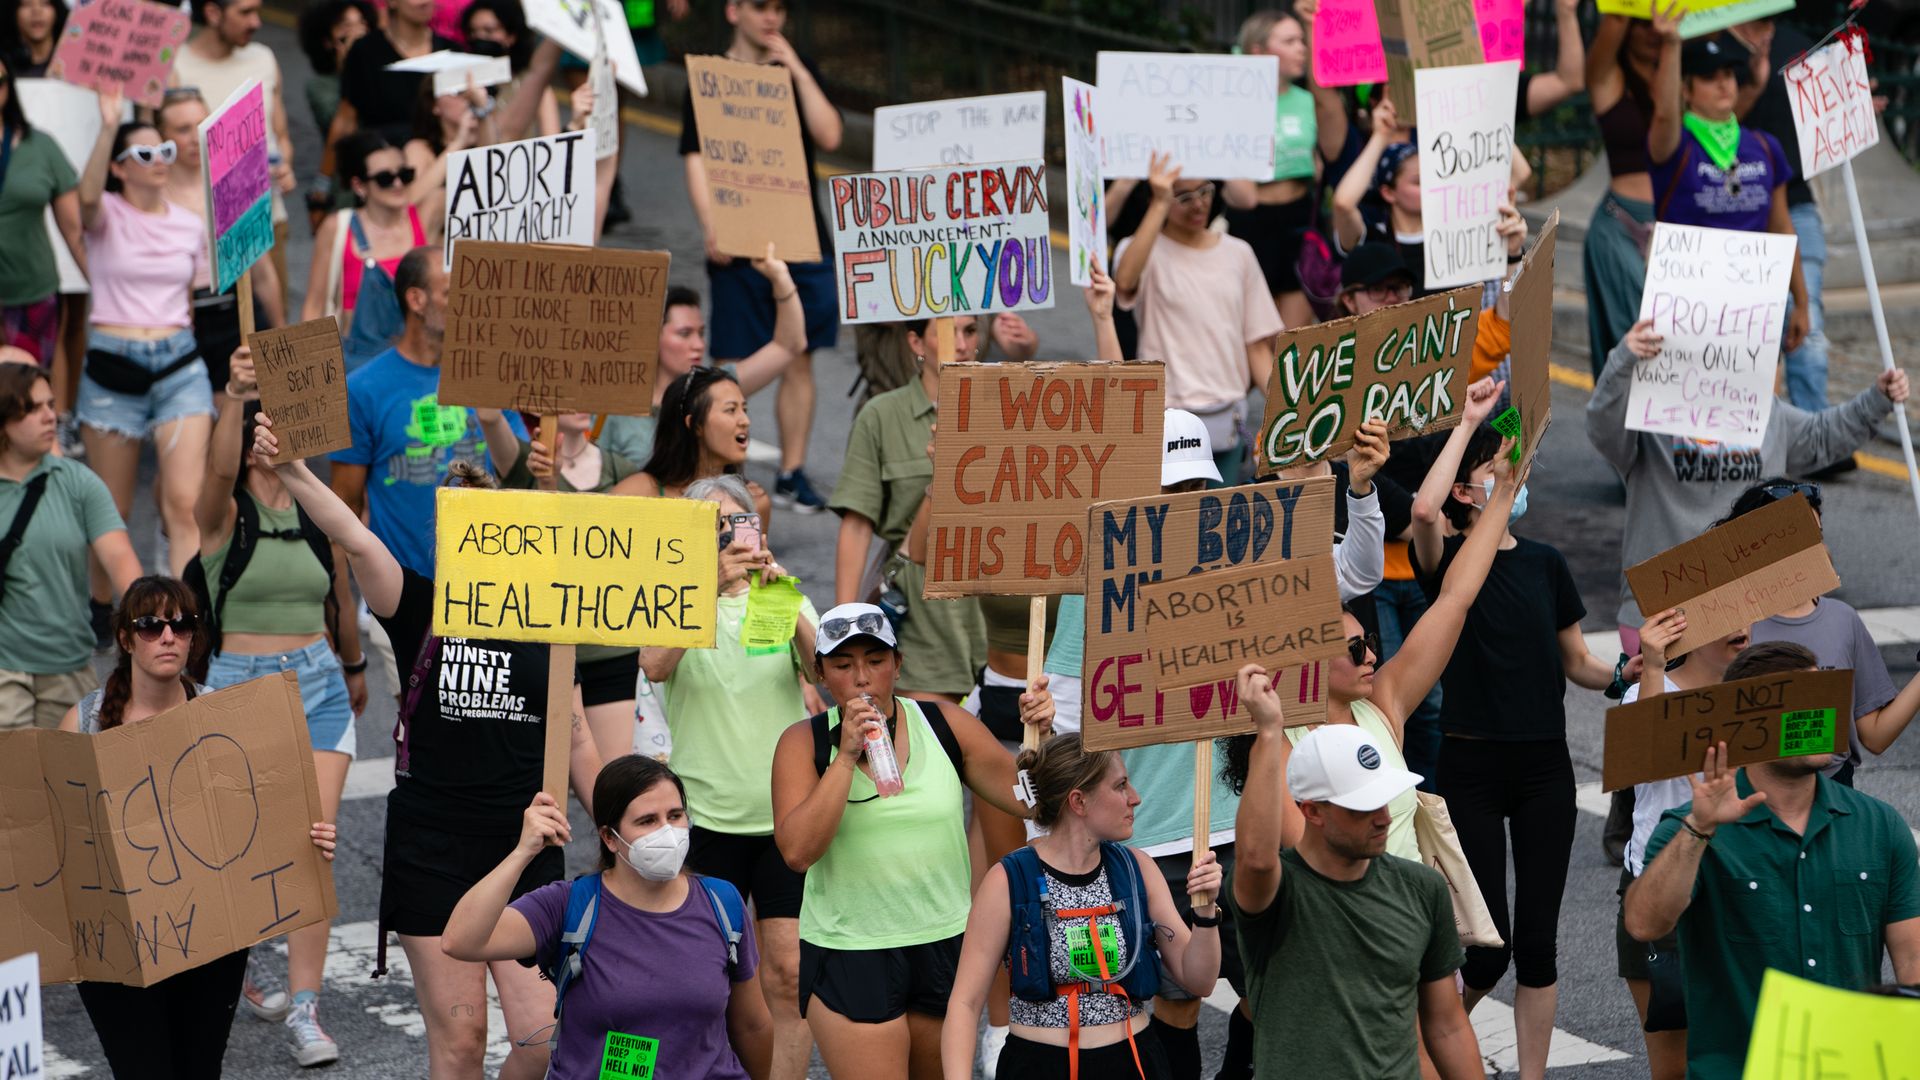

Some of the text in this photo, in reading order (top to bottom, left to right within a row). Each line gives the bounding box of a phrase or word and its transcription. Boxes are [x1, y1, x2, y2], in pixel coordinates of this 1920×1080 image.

[1119, 62, 1275, 101] ABORTION
[1796, 59, 1868, 124] NEVER
[890, 104, 1041, 140] STOP THE WAR
[1164, 103, 1200, 124] IS
[1813, 107, 1874, 171] AGAIN
[450, 134, 583, 215] ABORT
[832, 173, 936, 230] PUBLIC
[946, 164, 1048, 220] CERVIX
[857, 221, 1013, 249] ANNOUNCEMENT:
[524, 261, 556, 293] LIKE
[561, 263, 660, 298] ABORTIONS?
[843, 235, 1050, 319] FUCK YOU
[453, 294, 637, 325] JUST IGNORE THEM
[455, 319, 630, 353] LIKE YOU IGNORE
[1279, 297, 1473, 408] WE CAN'T
[287, 359, 337, 393] SENT US
[449, 349, 487, 381] THE
[498, 351, 573, 385] CHILDREN
[1703, 342, 1761, 374] ONLY
[265, 395, 327, 426] ABORTION IS
[516, 382, 564, 416] CARE
[957, 376, 1158, 434] I WON'T
[1265, 367, 1455, 467] GO BACK
[288, 424, 335, 455] NORMAL
[1168, 436, 1202, 453] prince
[954, 443, 1117, 505] CARRY
[458, 523, 685, 565] ABORTION IS
[1103, 485, 1304, 570] MY BODY
[933, 521, 1086, 582] HIS LO
[444, 580, 703, 631] HEALTHCARE
[1145, 566, 1310, 626] ABORTION
[1226, 610, 1246, 628] IS
[441, 645, 512, 668] NINETY
[1159, 620, 1345, 675] HEALTHCARE
[439, 662, 511, 693] NINE
[438, 689, 526, 712] PROBLEMS
[440, 705, 453, 715] BUT
[454, 708, 460, 717] A
[462, 709, 507, 720] PREGNANCY
[508, 712, 528, 722] AIN'T
[1663, 680, 1793, 720] IT'S NOT
[1681, 715, 1770, 760] 1973
[0, 733, 258, 897] OBJEC
[1070, 927, 1110, 940] OVERRN
[1074, 952, 1096, 966] HELL
[608, 1046, 630, 1059] ROE?
[610, 1035, 652, 1052] OVERTURN
[605, 1058, 628, 1075] HELL
[631, 1063, 650, 1079] NO!
